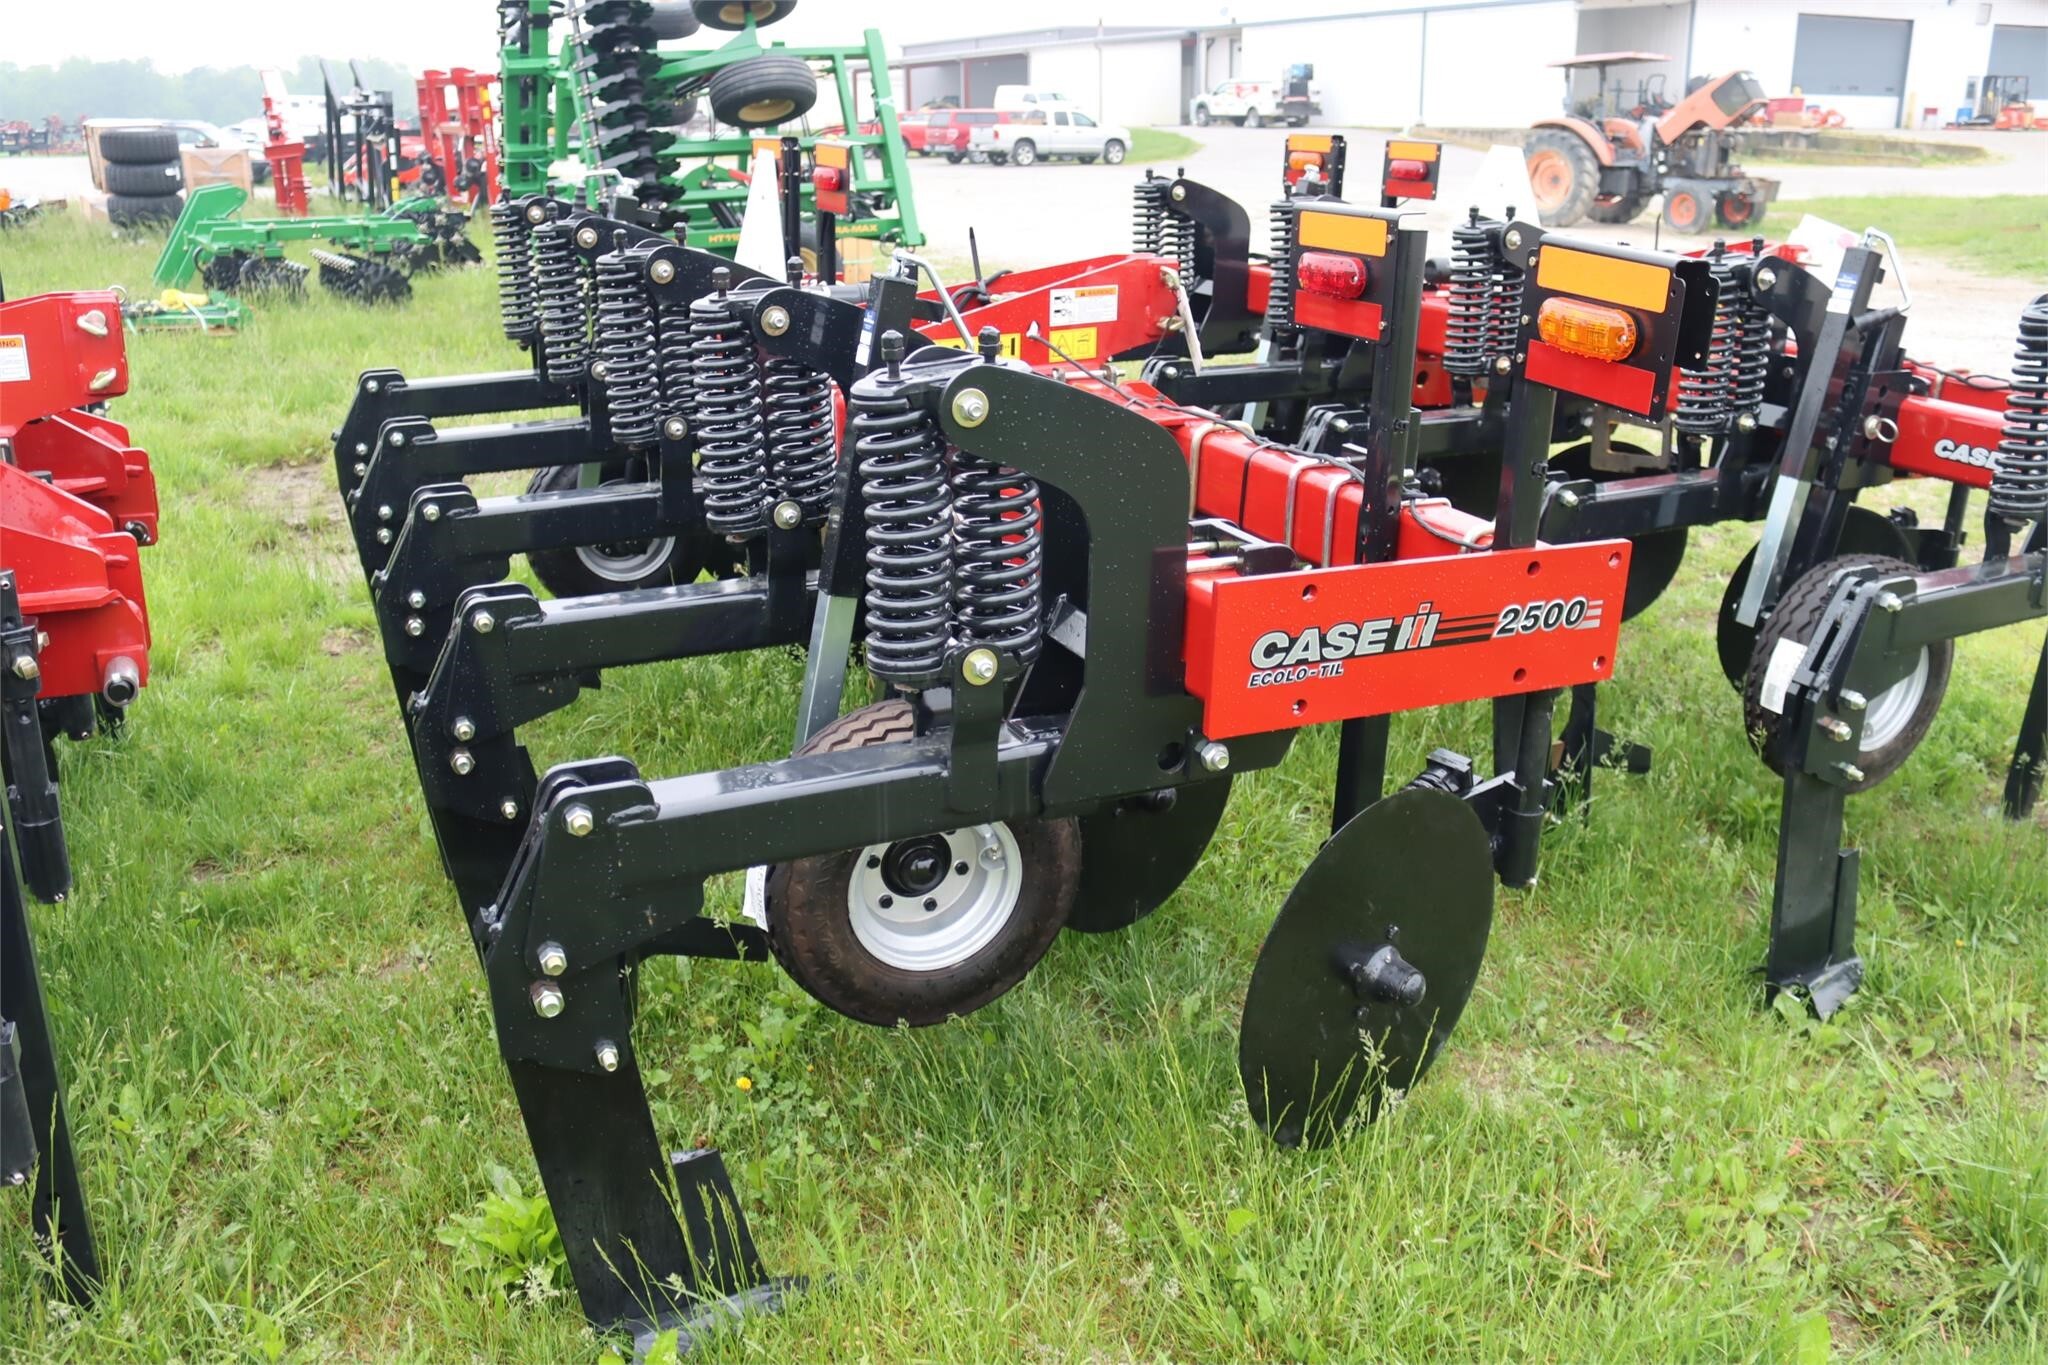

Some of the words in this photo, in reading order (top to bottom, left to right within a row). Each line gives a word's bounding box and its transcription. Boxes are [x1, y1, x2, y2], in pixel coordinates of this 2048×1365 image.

[1250, 617, 1394, 670] CASE
[1493, 596, 1587, 637] 2500
[1248, 661, 1344, 688] ECOLO-TIL
